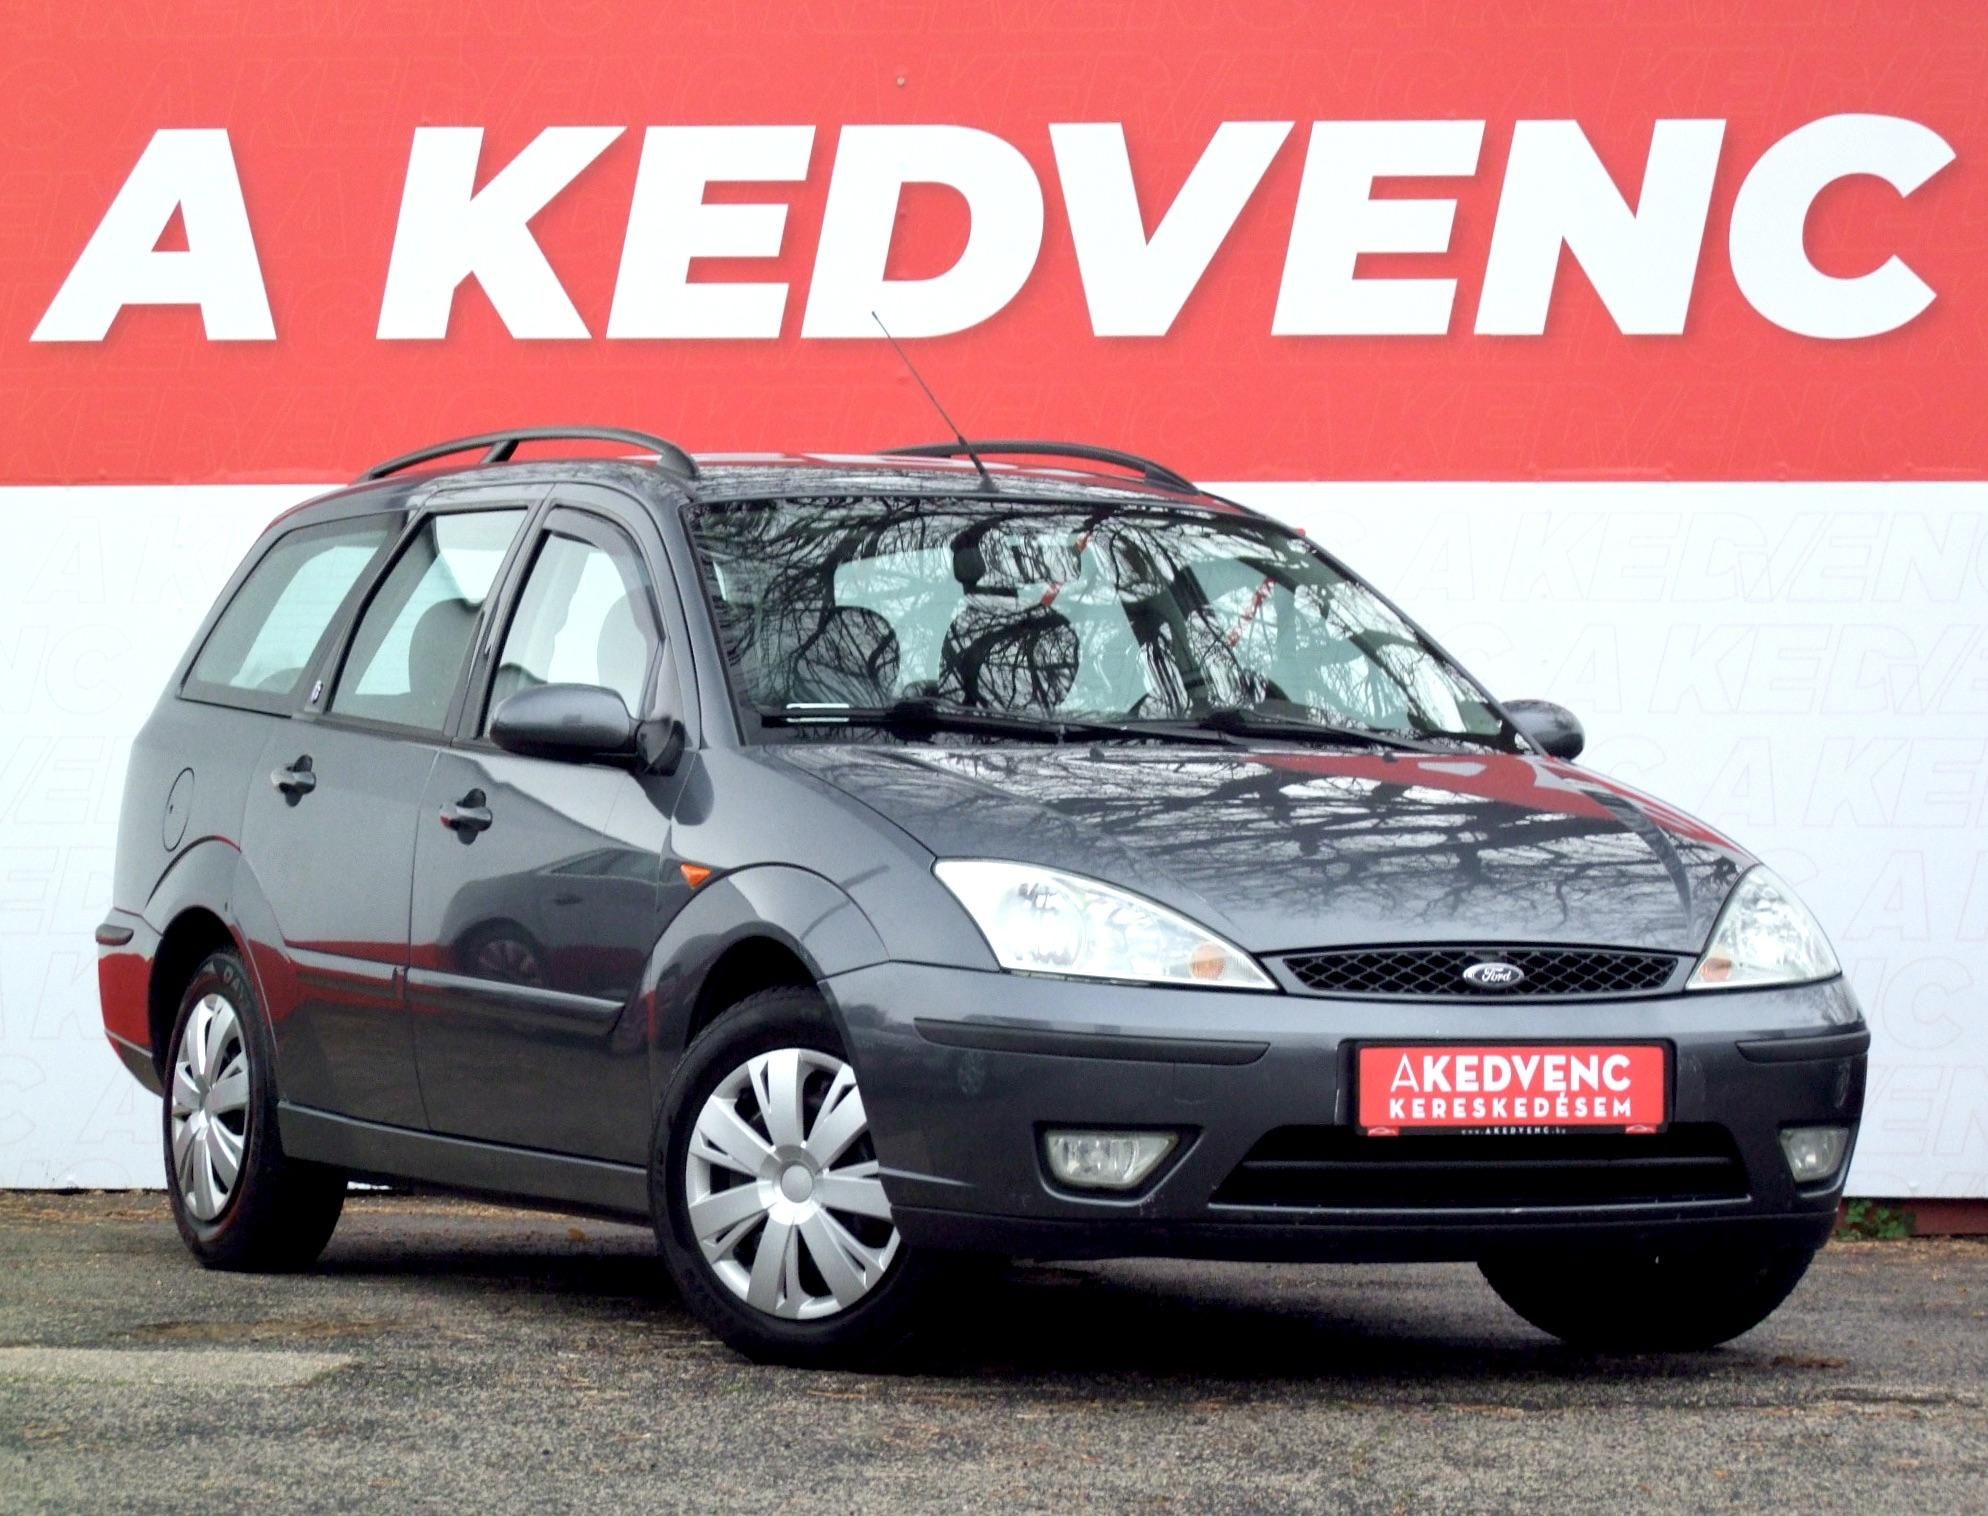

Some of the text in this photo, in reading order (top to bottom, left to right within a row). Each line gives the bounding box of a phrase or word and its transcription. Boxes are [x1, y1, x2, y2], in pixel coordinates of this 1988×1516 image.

[30, 128, 277, 344] A
[376, 112, 1956, 342] KEDVENC
[1482, 967, 1511, 982] Ford
[1389, 1092, 1632, 1119] KERESKEDÉSEM
